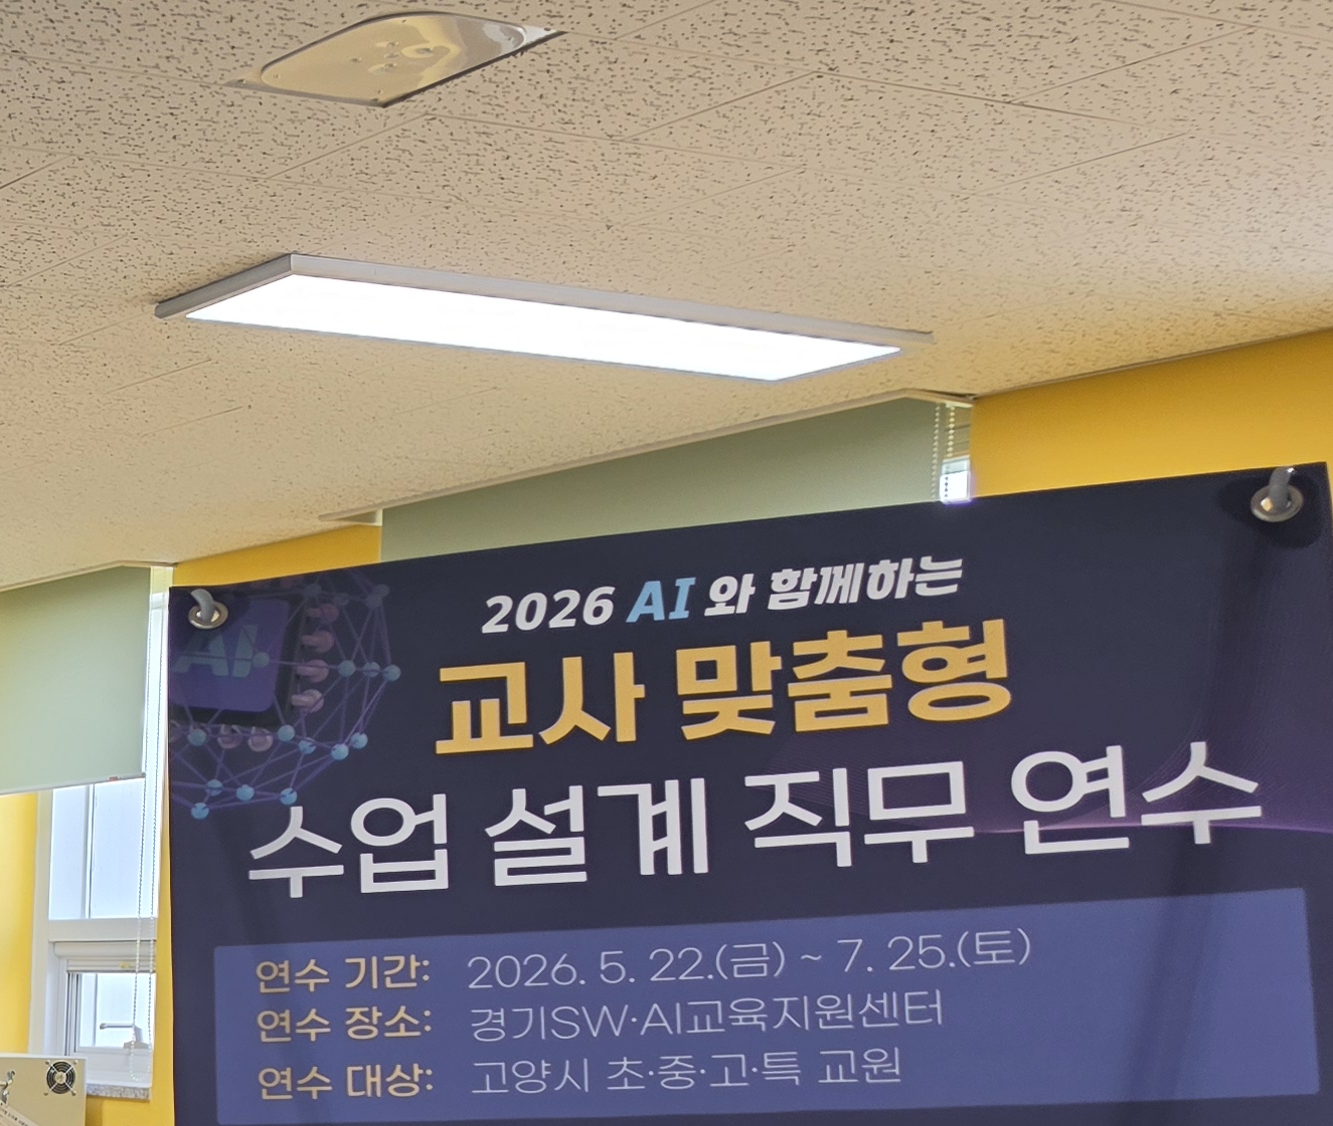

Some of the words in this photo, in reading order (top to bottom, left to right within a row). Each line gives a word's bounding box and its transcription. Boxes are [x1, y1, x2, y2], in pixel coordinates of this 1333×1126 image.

[481, 586, 616, 634] 2026
[626, 577, 696, 623] AI
[704, 573, 756, 616] 와
[767, 556, 963, 610] 함께하는
[436, 652, 645, 754] 교사
[676, 619, 1012, 740] 맞춤형
[248, 783, 449, 898] 수업
[484, 778, 709, 886] 설계
[744, 761, 977, 867] 직무
[1010, 741, 1264, 855] 연수
[256, 959, 329, 992] 연수
[345, 954, 429, 989] 기간:
[468, 954, 585, 988] 2026.
[600, 951, 635, 983] 5.
[650, 942, 785, 981] 22.(금)
[837, 939, 873, 972] 7.
[888, 928, 1030, 970] 25.(토)
[258, 1008, 331, 1042] 연수
[346, 1006, 431, 1039] 장소:
[259, 1067, 332, 1099] 연수
[347, 1063, 433, 1097] 대상:
[472, 1058, 588, 1093] 고양시
[818, 1047, 901, 1083] 교원
